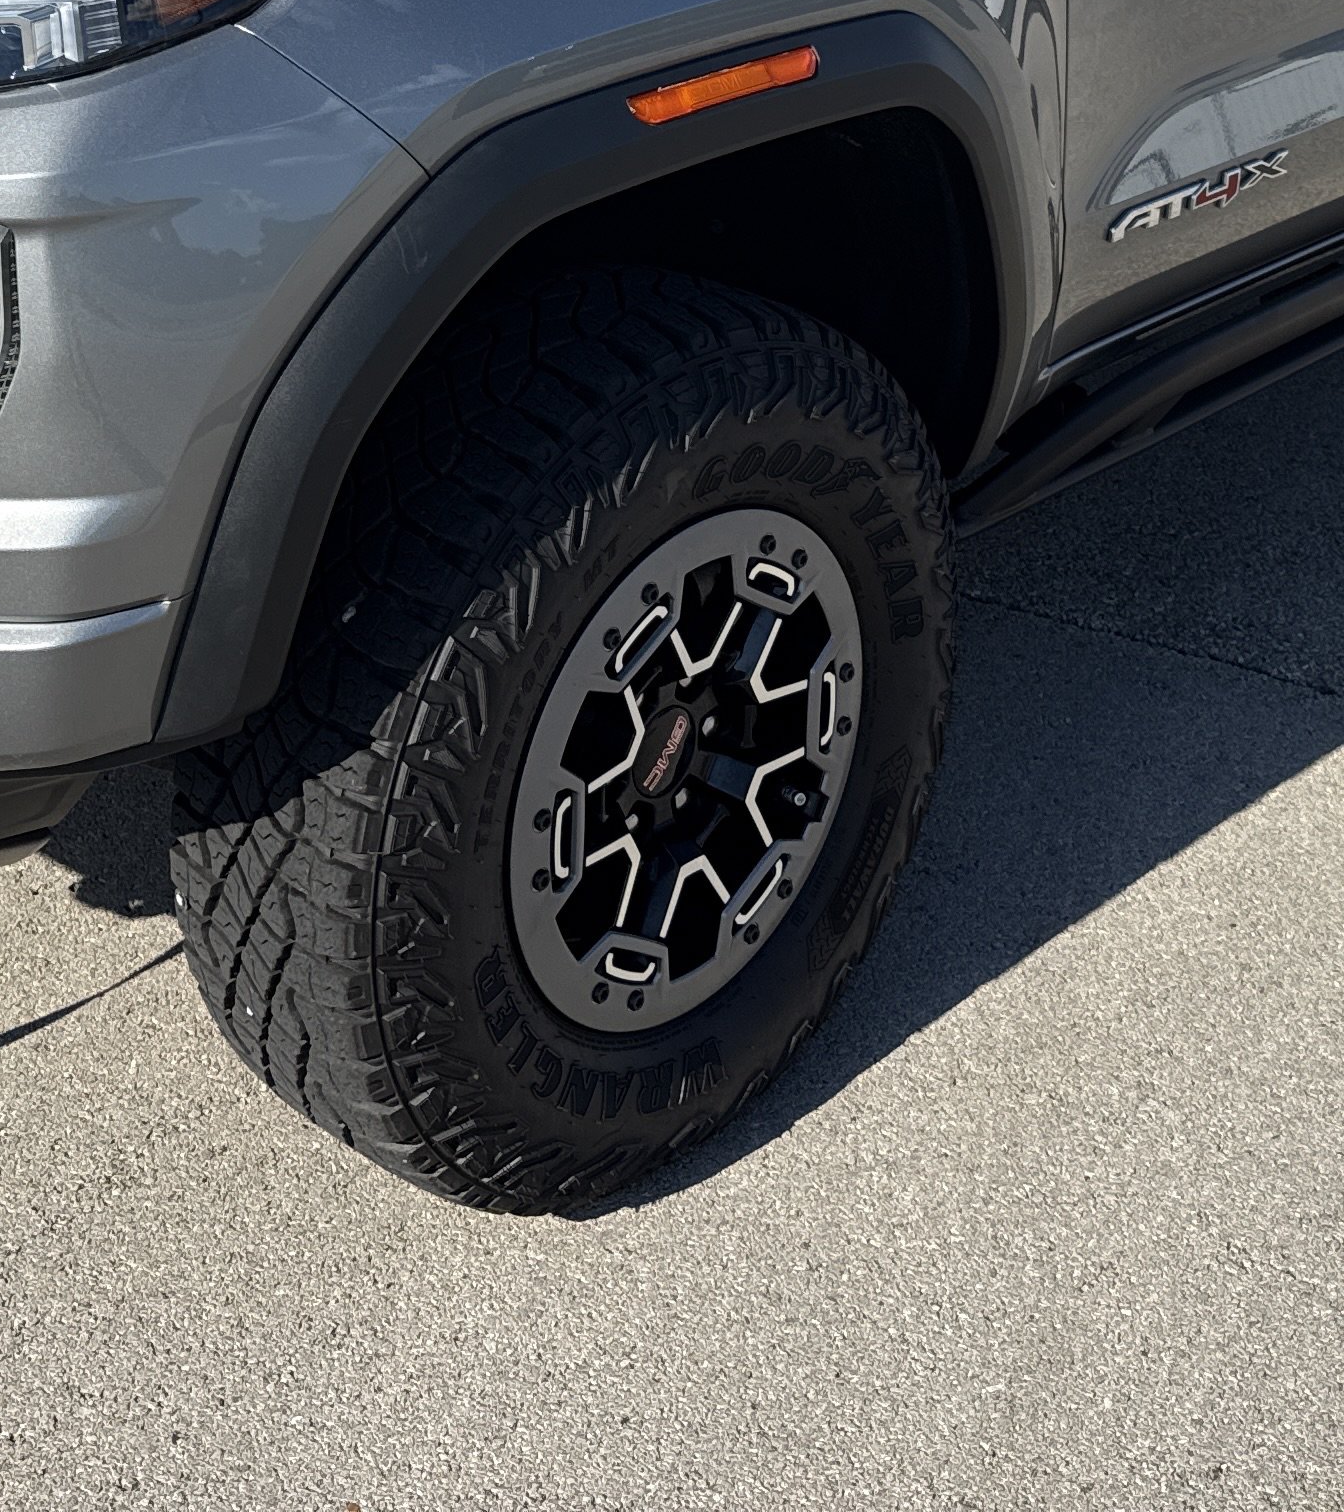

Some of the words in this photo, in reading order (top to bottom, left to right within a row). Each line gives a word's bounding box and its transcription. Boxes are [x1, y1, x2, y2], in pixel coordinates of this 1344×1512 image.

[1108, 148, 1289, 243] AT4X
[643, 715, 688, 792] GMC
[474, 944, 728, 1121] WRANGLER
